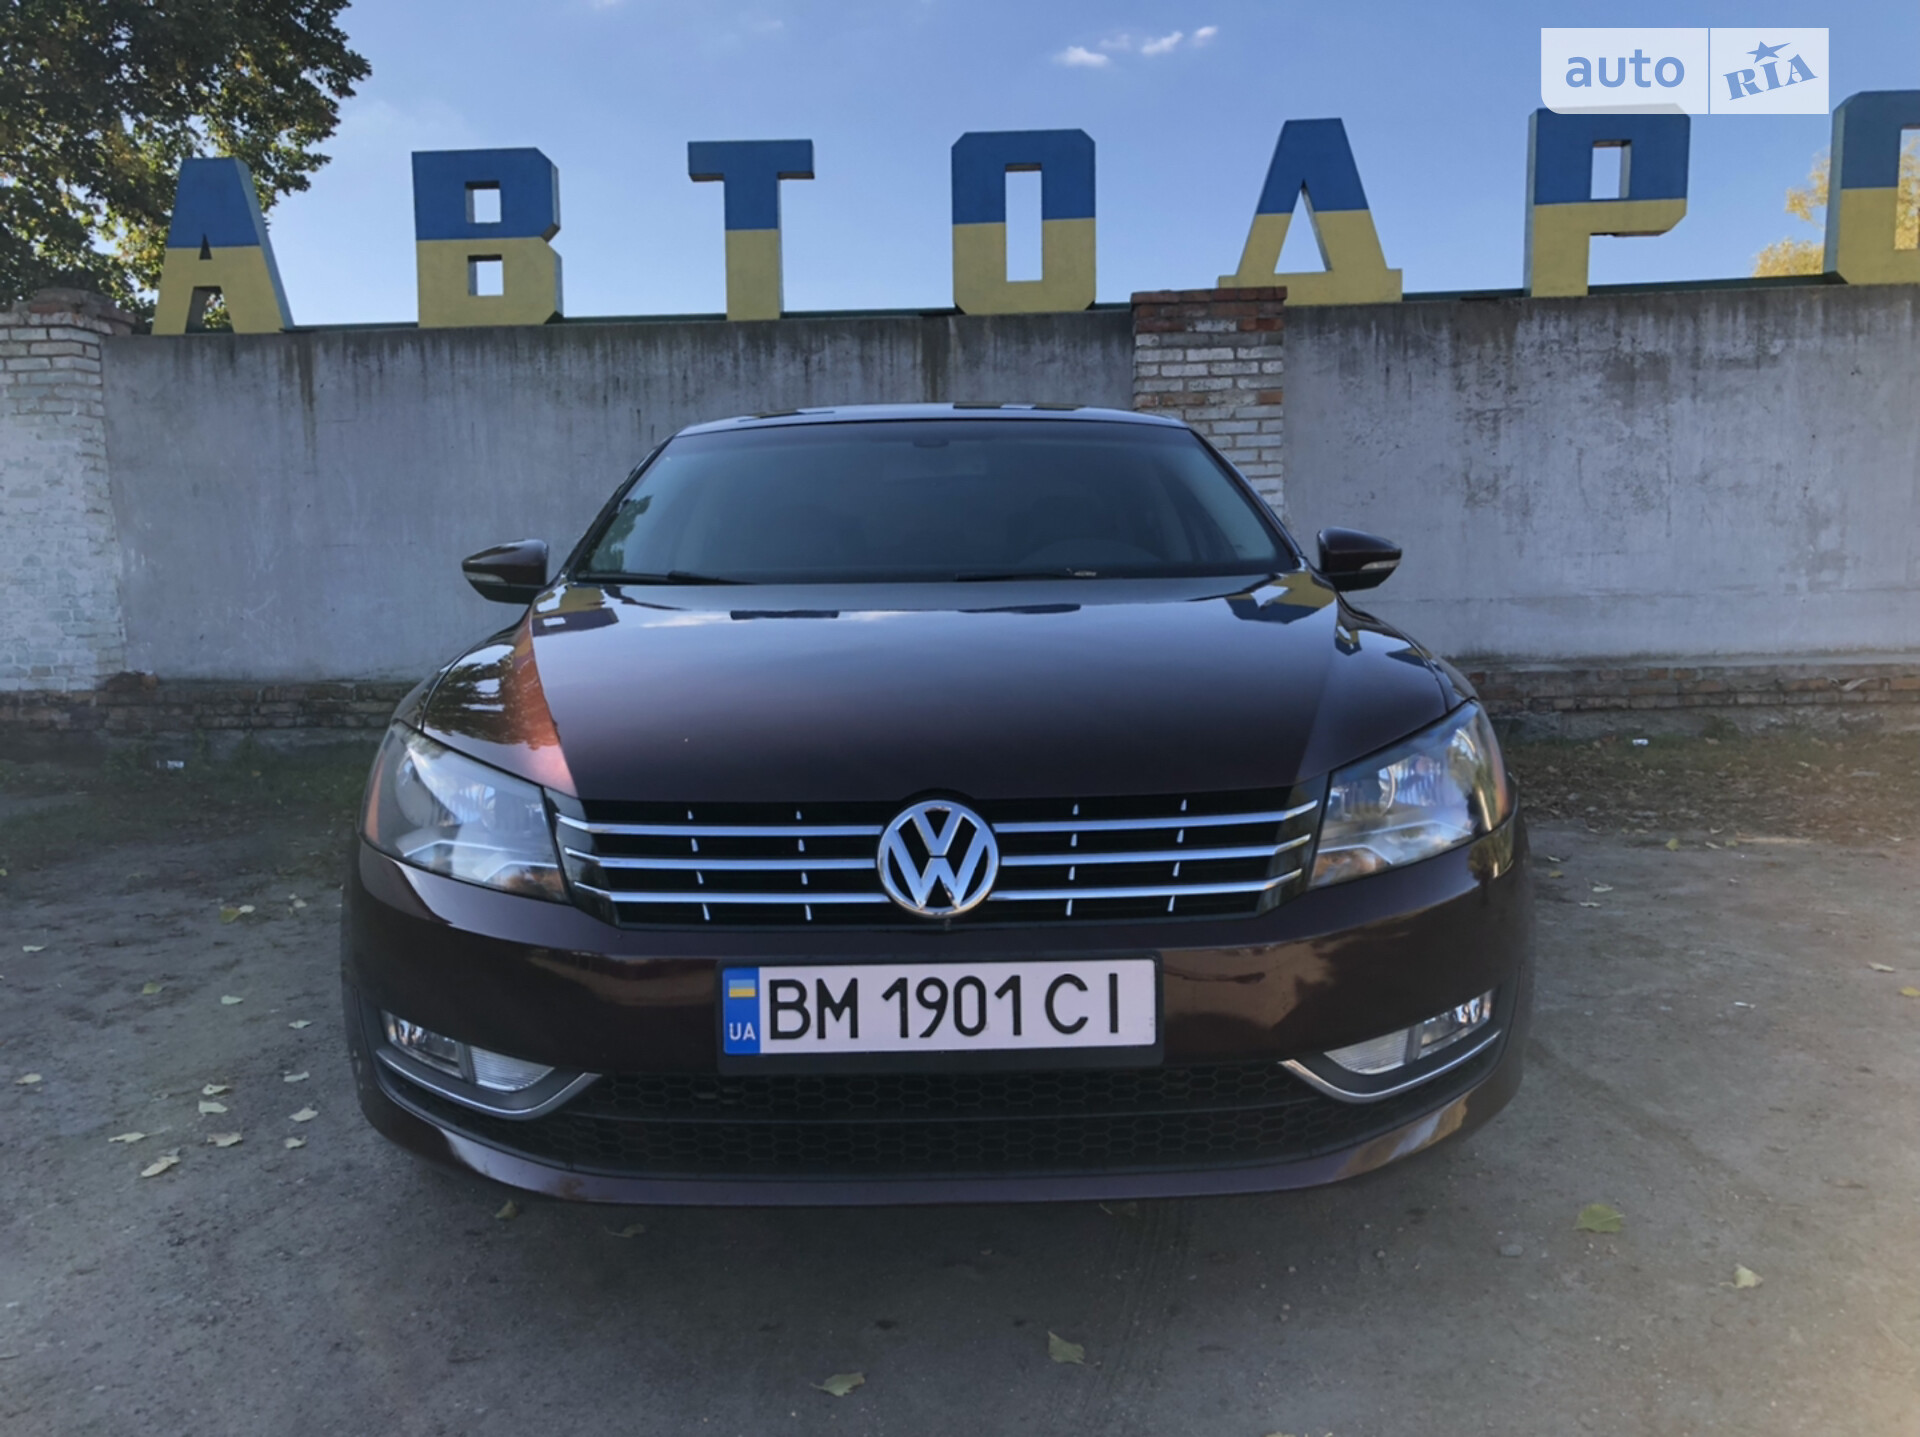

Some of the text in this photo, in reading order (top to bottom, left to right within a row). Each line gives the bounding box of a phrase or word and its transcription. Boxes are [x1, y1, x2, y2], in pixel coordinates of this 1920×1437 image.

[768, 972, 1120, 1041] BM 1901 CI
[728, 1022, 756, 1042] UA
